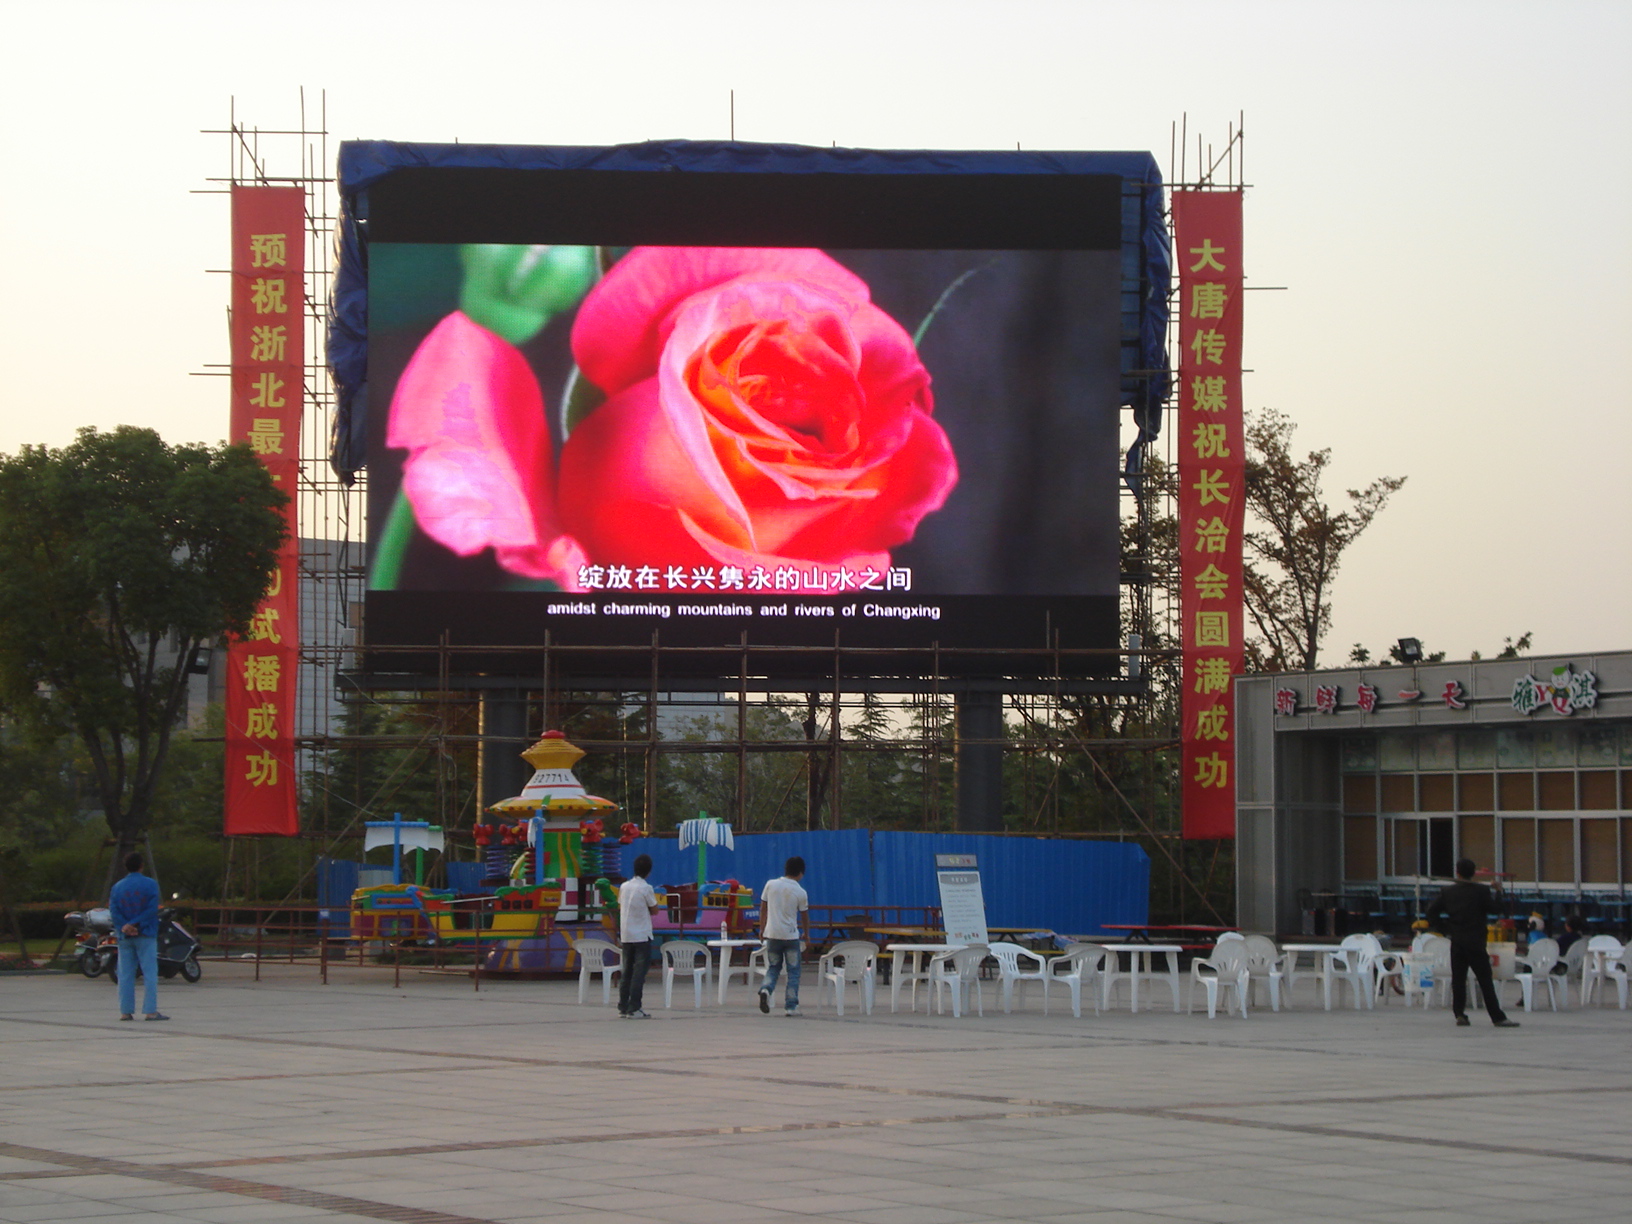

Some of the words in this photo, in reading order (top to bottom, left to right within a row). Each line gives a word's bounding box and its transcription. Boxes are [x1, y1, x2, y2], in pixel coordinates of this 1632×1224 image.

[1189, 238, 1231, 789] 大唐传媒祝长洽会圆满成功
[578, 565, 912, 592] 绽放在长兴隽永的山水之间
[547, 602, 596, 615] amidst
[603, 602, 671, 618] charming
[678, 603, 753, 616] mountains
[760, 603, 788, 616] and
[794, 604, 835, 616] rivers
[841, 604, 857, 616] of
[863, 604, 941, 620] Changxing
